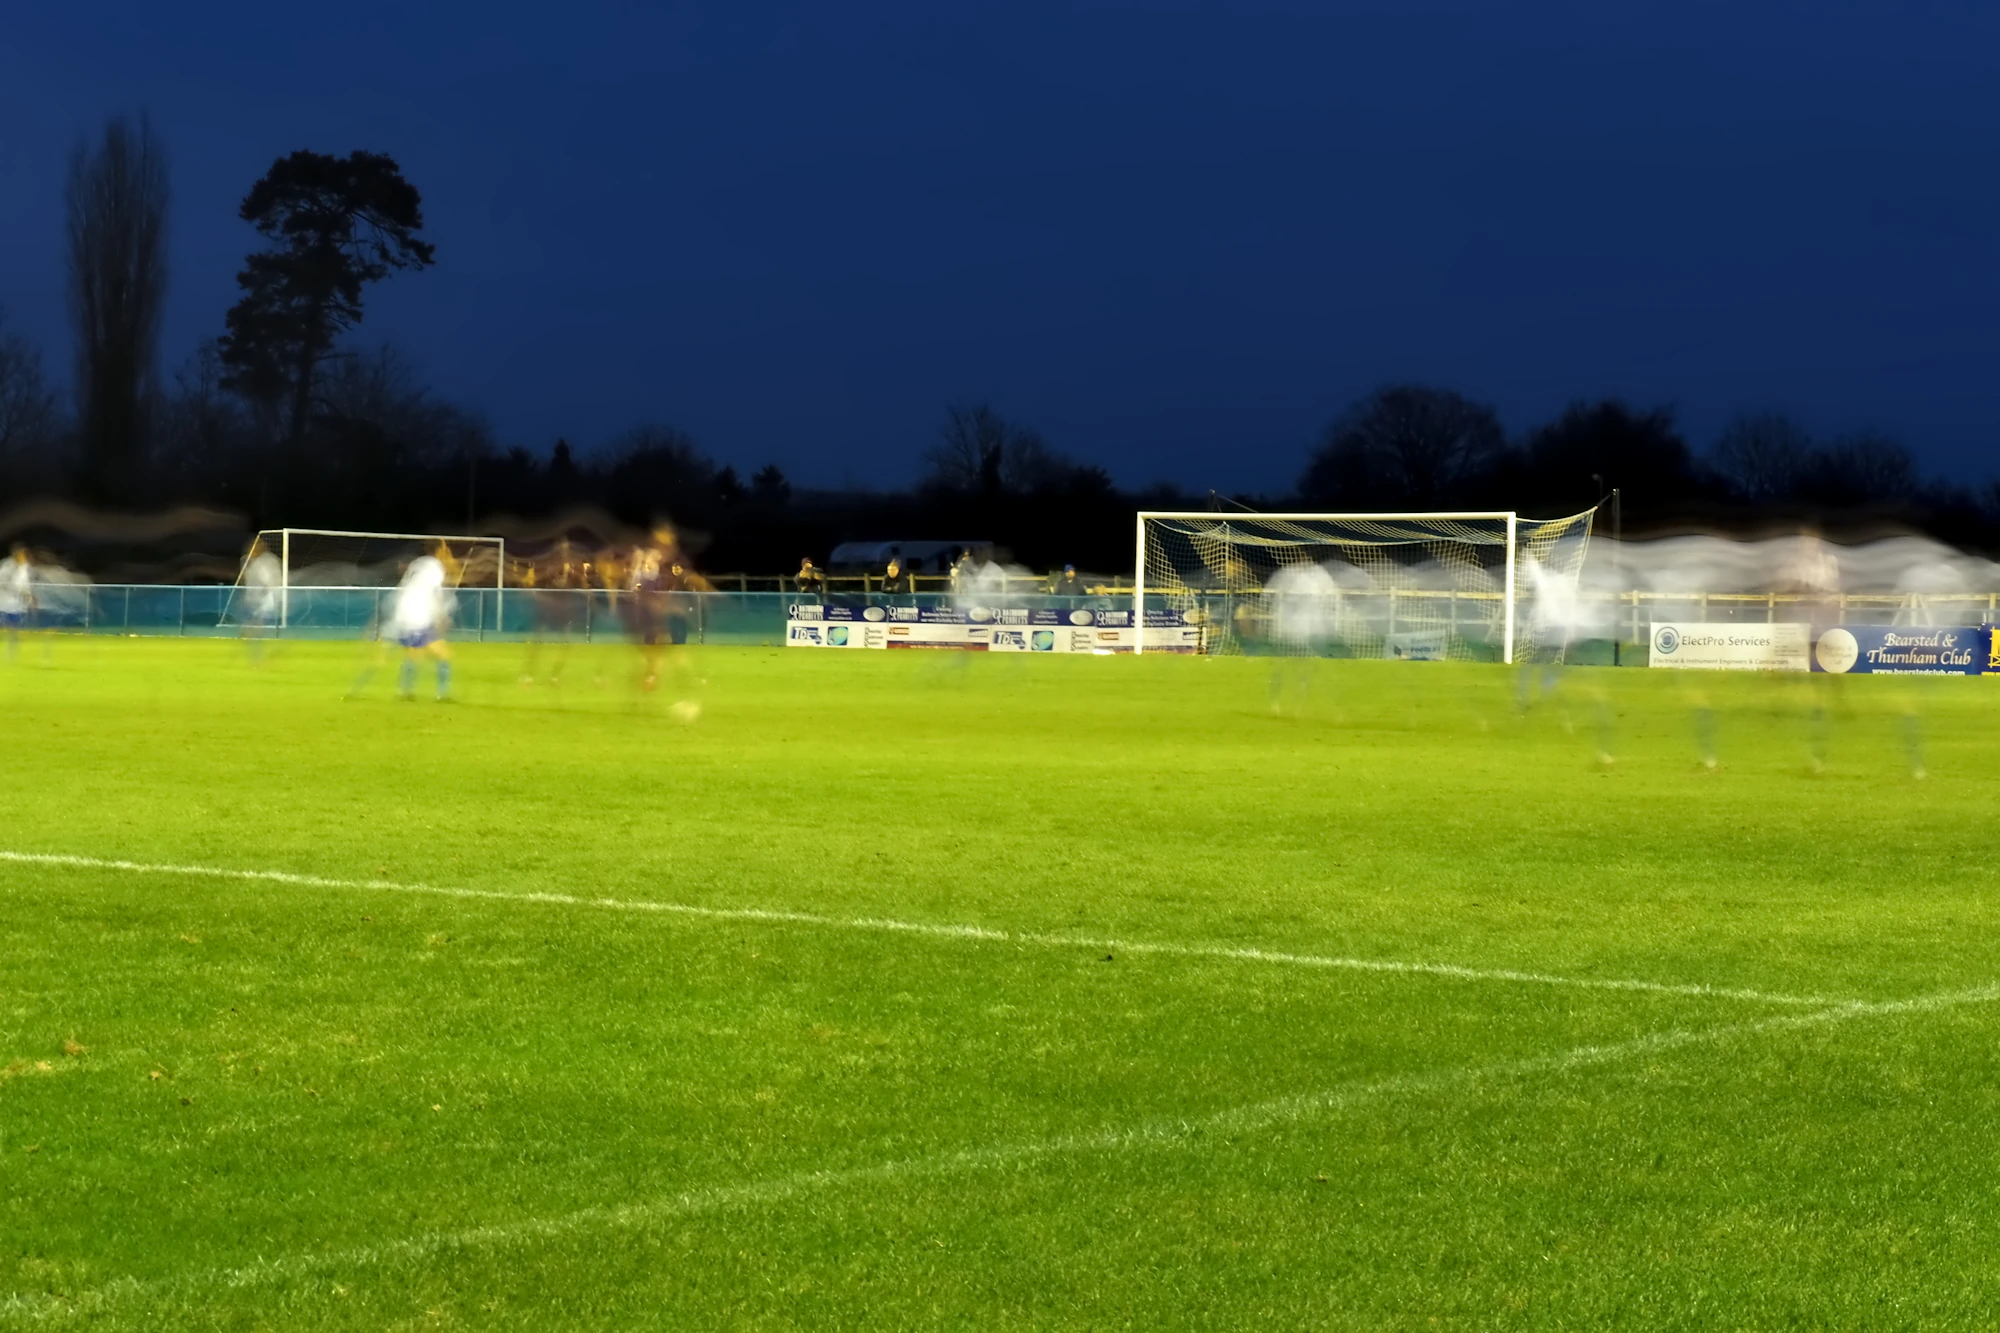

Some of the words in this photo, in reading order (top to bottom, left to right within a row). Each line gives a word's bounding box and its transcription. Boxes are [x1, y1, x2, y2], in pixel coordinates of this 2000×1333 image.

[798, 612, 824, 620] PRODUCTS
[1002, 616, 1028, 624] PRODUCTS
[1682, 635, 1724, 646] ElectPro
[1728, 636, 1770, 646] Services
[1884, 630, 1942, 647] Bearsted
[1942, 633, 1958, 647] &
[1866, 646, 1938, 664] Thurnham
[1940, 648, 1972, 665] Club
